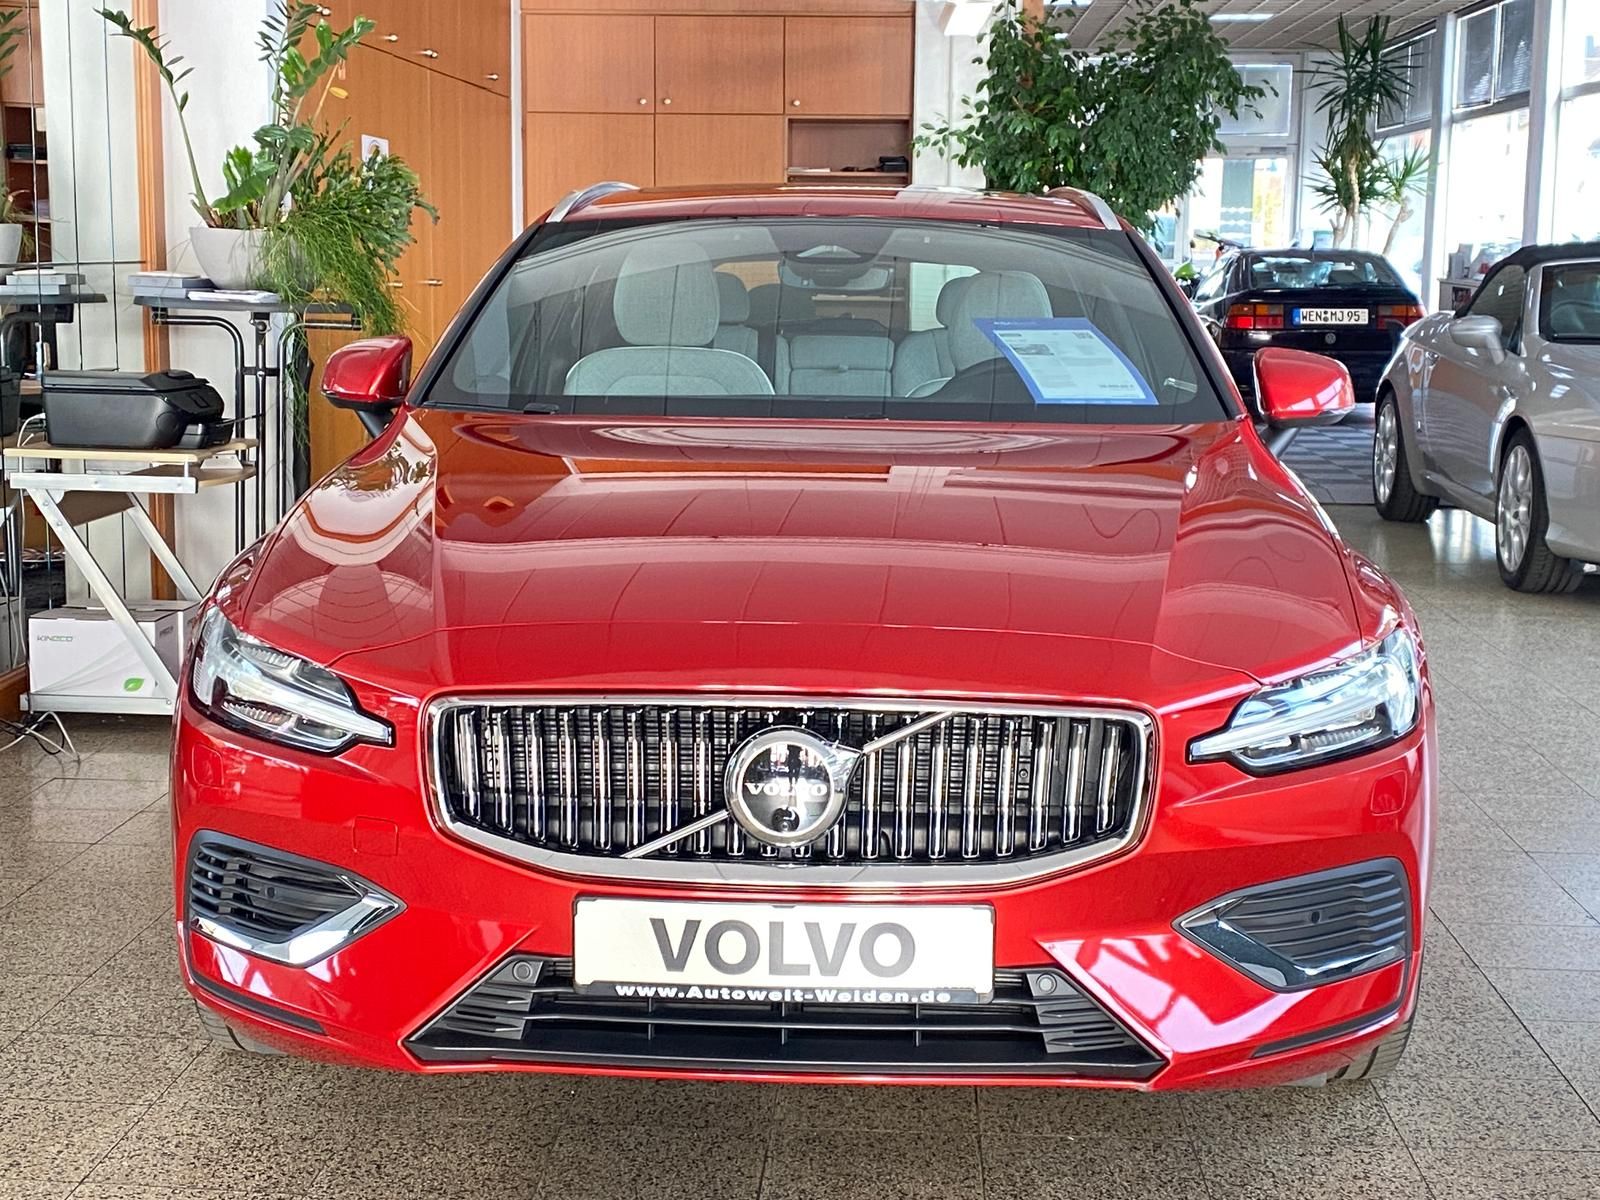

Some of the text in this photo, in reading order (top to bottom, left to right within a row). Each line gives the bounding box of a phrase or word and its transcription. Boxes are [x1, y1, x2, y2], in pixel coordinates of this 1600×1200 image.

[1302, 310, 1322, 322] WEN
[1330, 310, 1344, 322] MJ
[1347, 310, 1360, 322] 95
[649, 918, 916, 978] VOLVO
